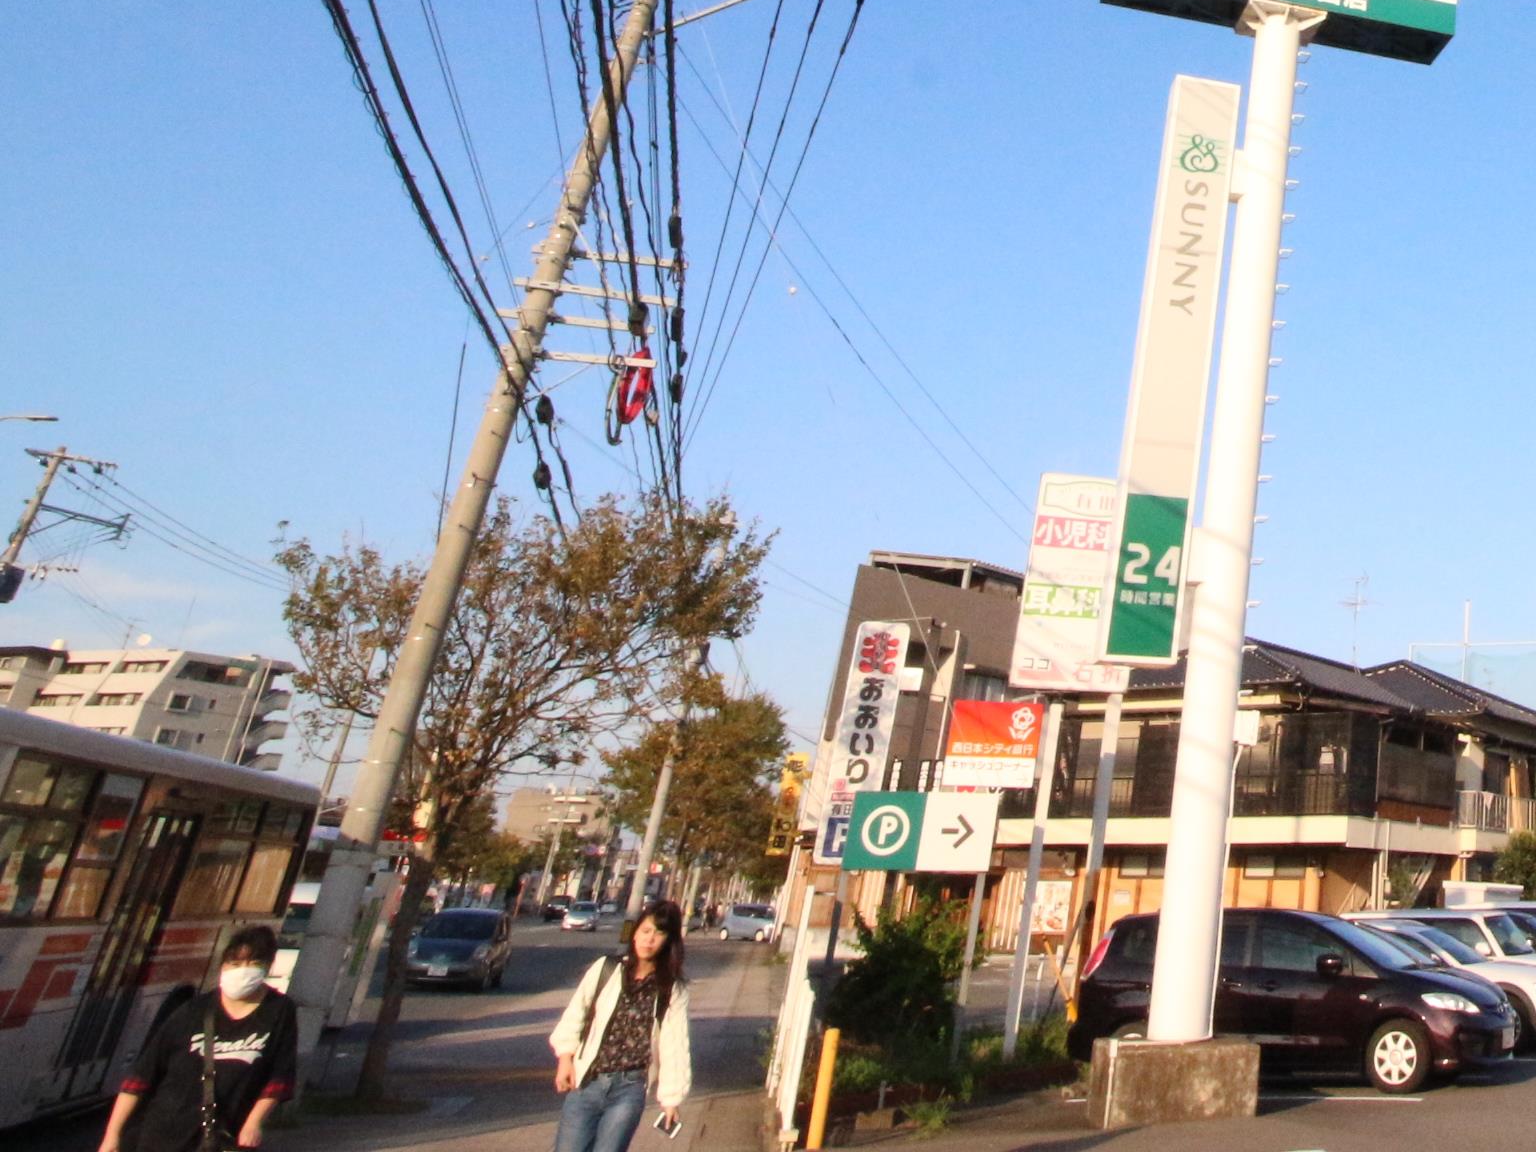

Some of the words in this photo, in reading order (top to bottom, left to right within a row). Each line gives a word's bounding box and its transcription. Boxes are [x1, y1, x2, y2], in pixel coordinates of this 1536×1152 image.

[1168, 179, 1209, 316] SUNNY
[1123, 542, 1181, 586] 24
[951, 741, 1034, 756] 西日本シティ銀行
